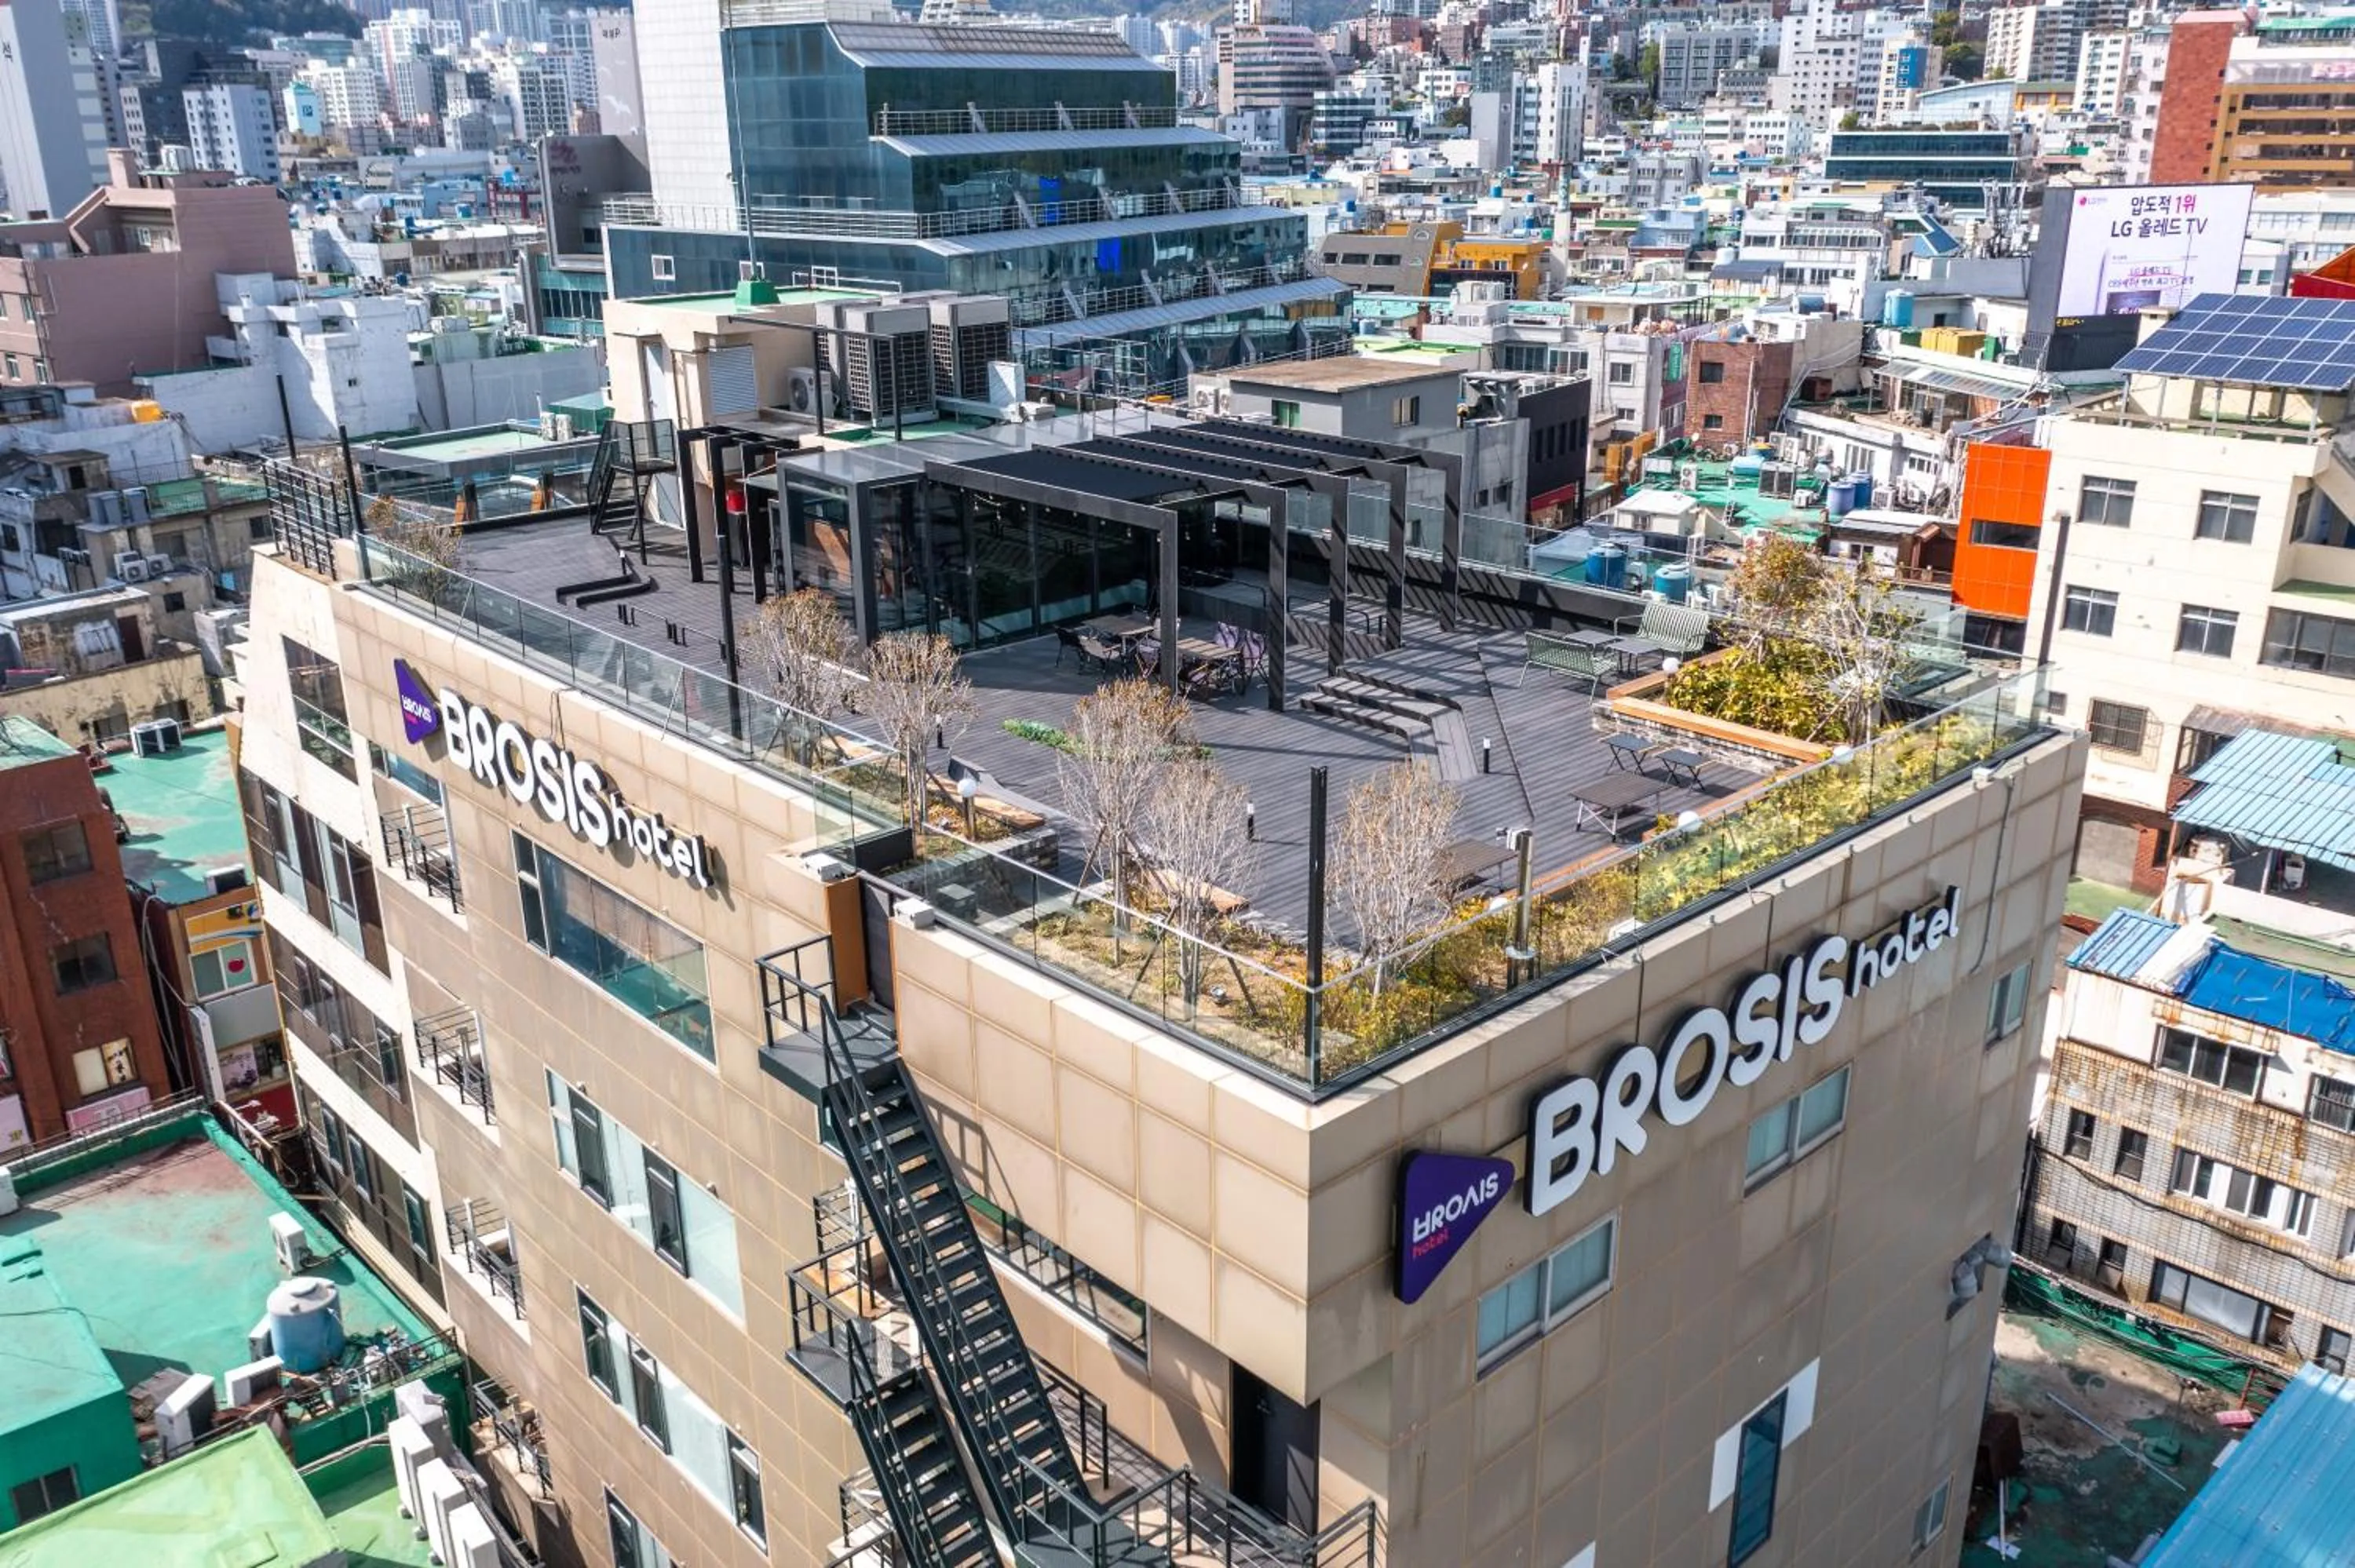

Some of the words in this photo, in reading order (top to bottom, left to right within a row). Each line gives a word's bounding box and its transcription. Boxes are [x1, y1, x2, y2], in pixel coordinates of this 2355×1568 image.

[2130, 195, 2172, 216] 압도적
[2175, 194, 2197, 214] 1위
[2110, 221, 2133, 238] LG
[2138, 217, 2182, 238] 올레드
[2185, 217, 2208, 235] TV
[439, 687, 610, 848] BROSIS
[610, 792, 711, 888] hotel
[1524, 935, 1848, 1216] BROSIS
[1850, 885, 1960, 997] hotel
[1411, 1227, 1450, 1260] hotel
